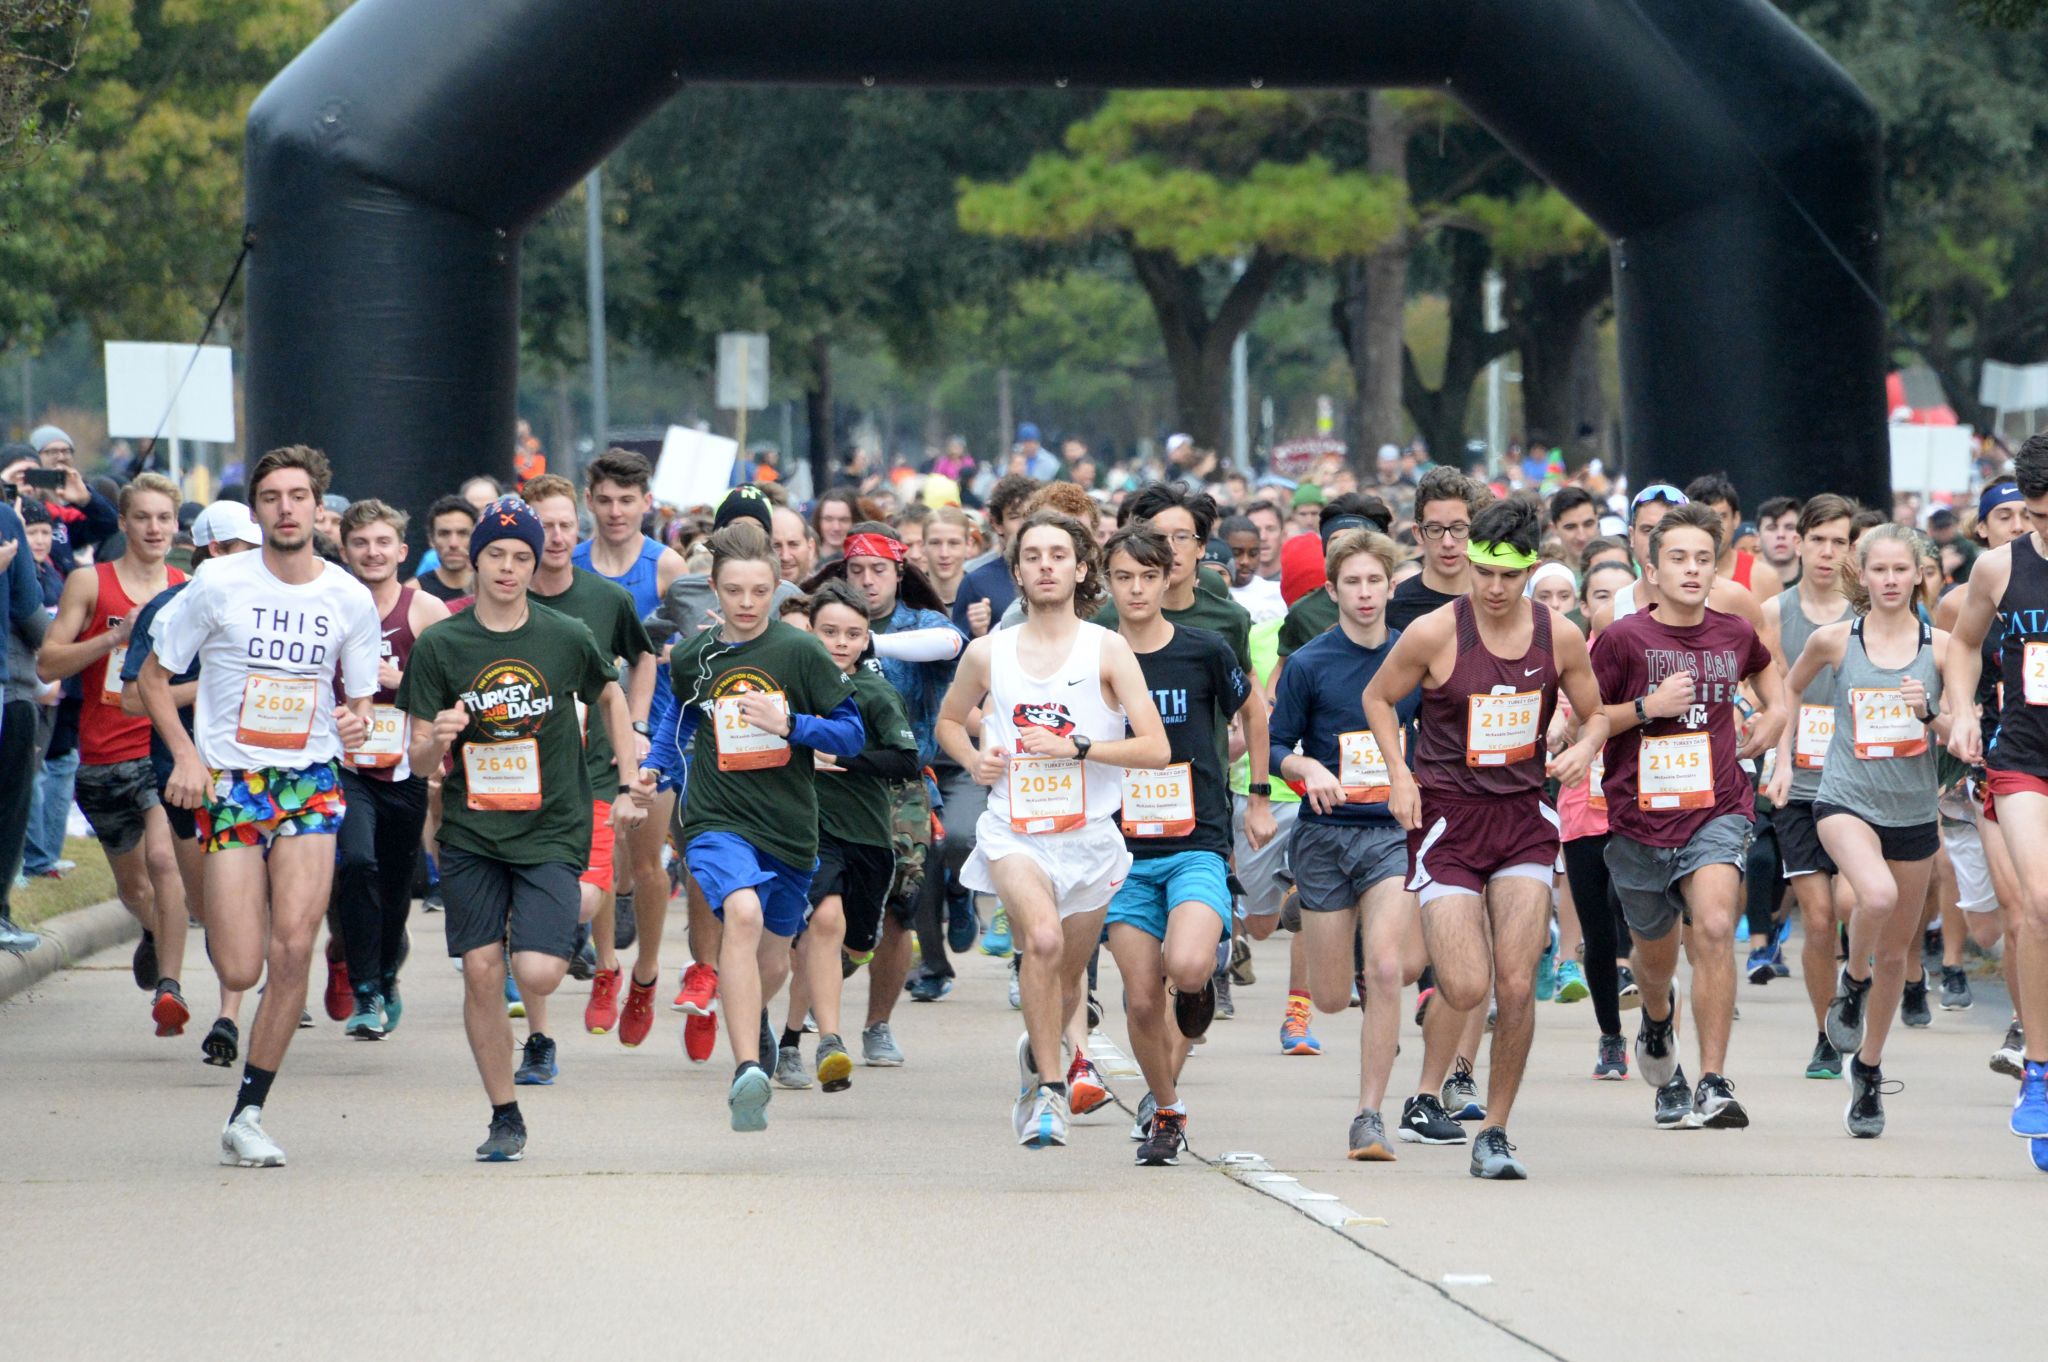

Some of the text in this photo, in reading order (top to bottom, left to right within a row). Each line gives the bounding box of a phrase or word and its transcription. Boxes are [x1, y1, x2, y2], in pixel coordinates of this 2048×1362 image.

[252, 608, 329, 637] THIS
[247, 637, 326, 665] GOOD
[1645, 649, 1738, 682] TEXAS A&M
[464, 683, 531, 712] TURKEY
[1648, 683, 1736, 702] AIES
[255, 694, 305, 712] 2602
[507, 696, 553, 719] DASH
[1481, 710, 1531, 728] 2138
[476, 756, 527, 771] 2640
[1649, 752, 1700, 770] 2145
[1020, 774, 1072, 793] 2054
[1131, 782, 1180, 800] 2103
